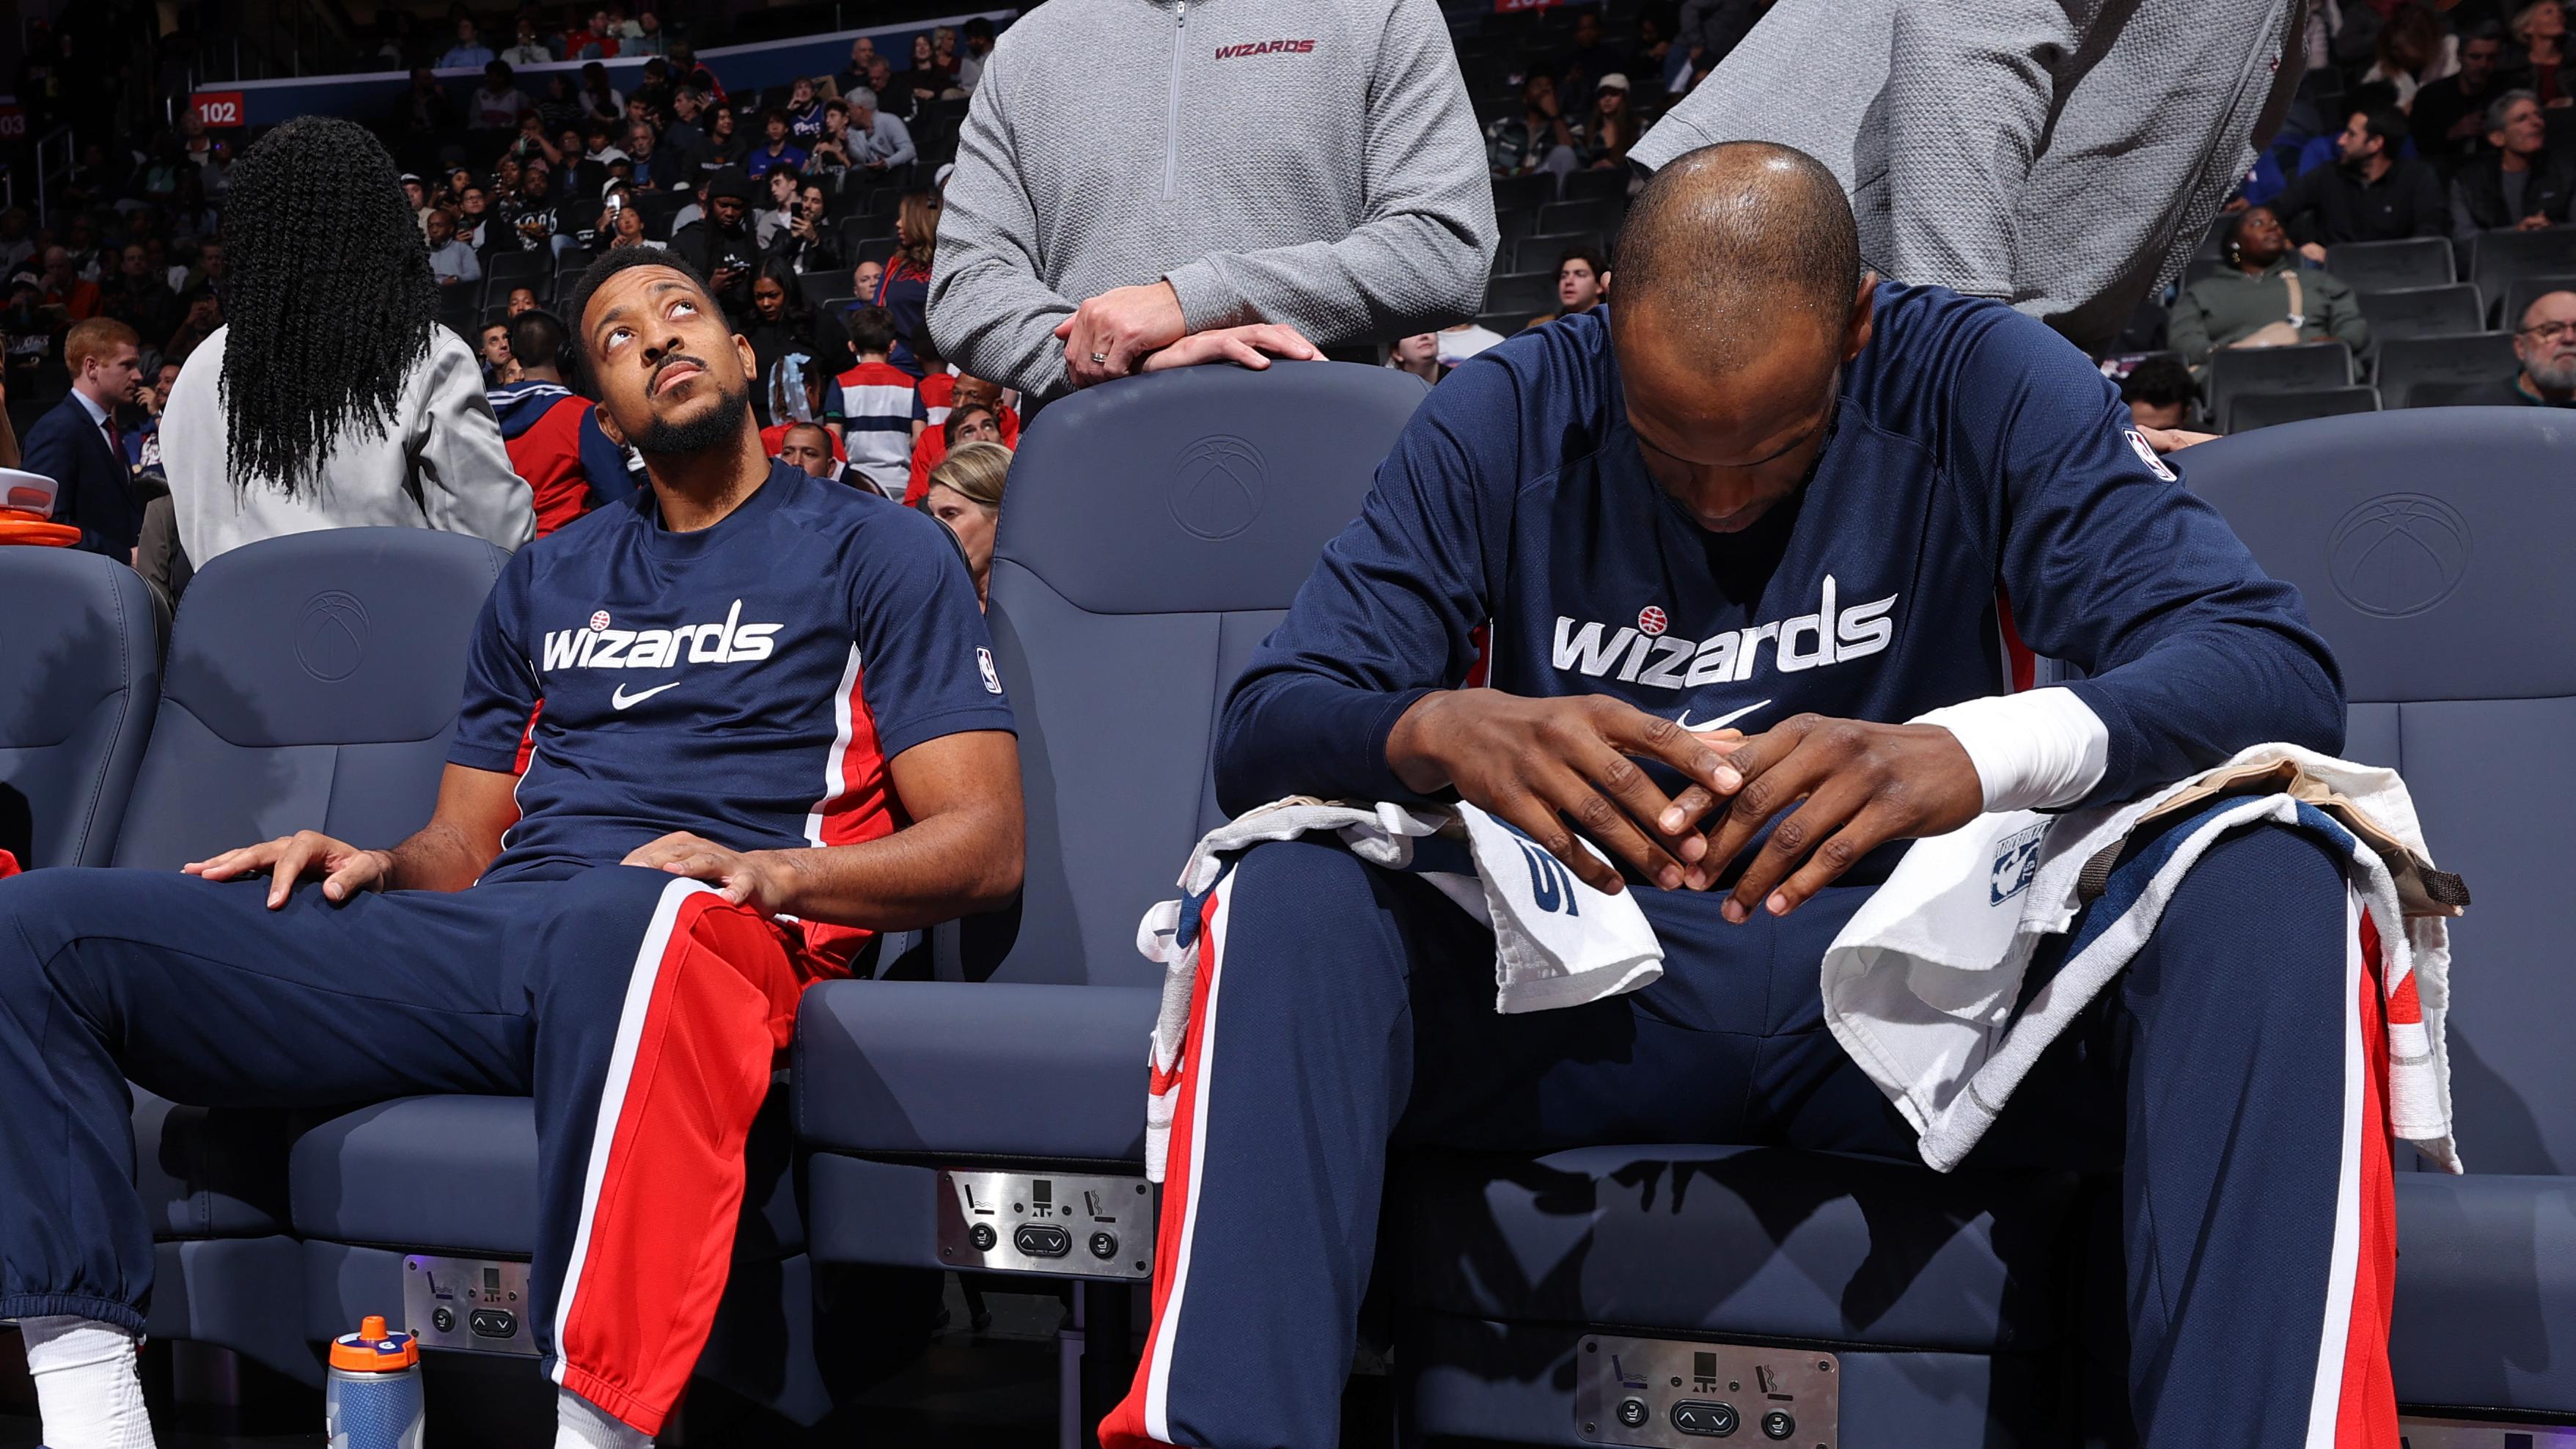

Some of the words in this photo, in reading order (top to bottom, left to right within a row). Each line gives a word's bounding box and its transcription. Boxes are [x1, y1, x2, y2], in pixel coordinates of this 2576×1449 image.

[1215, 40, 1315, 60] WIZARDS
[199, 102, 236, 123] 102
[543, 599, 785, 672] wizards
[1552, 574, 1898, 689] wizards
